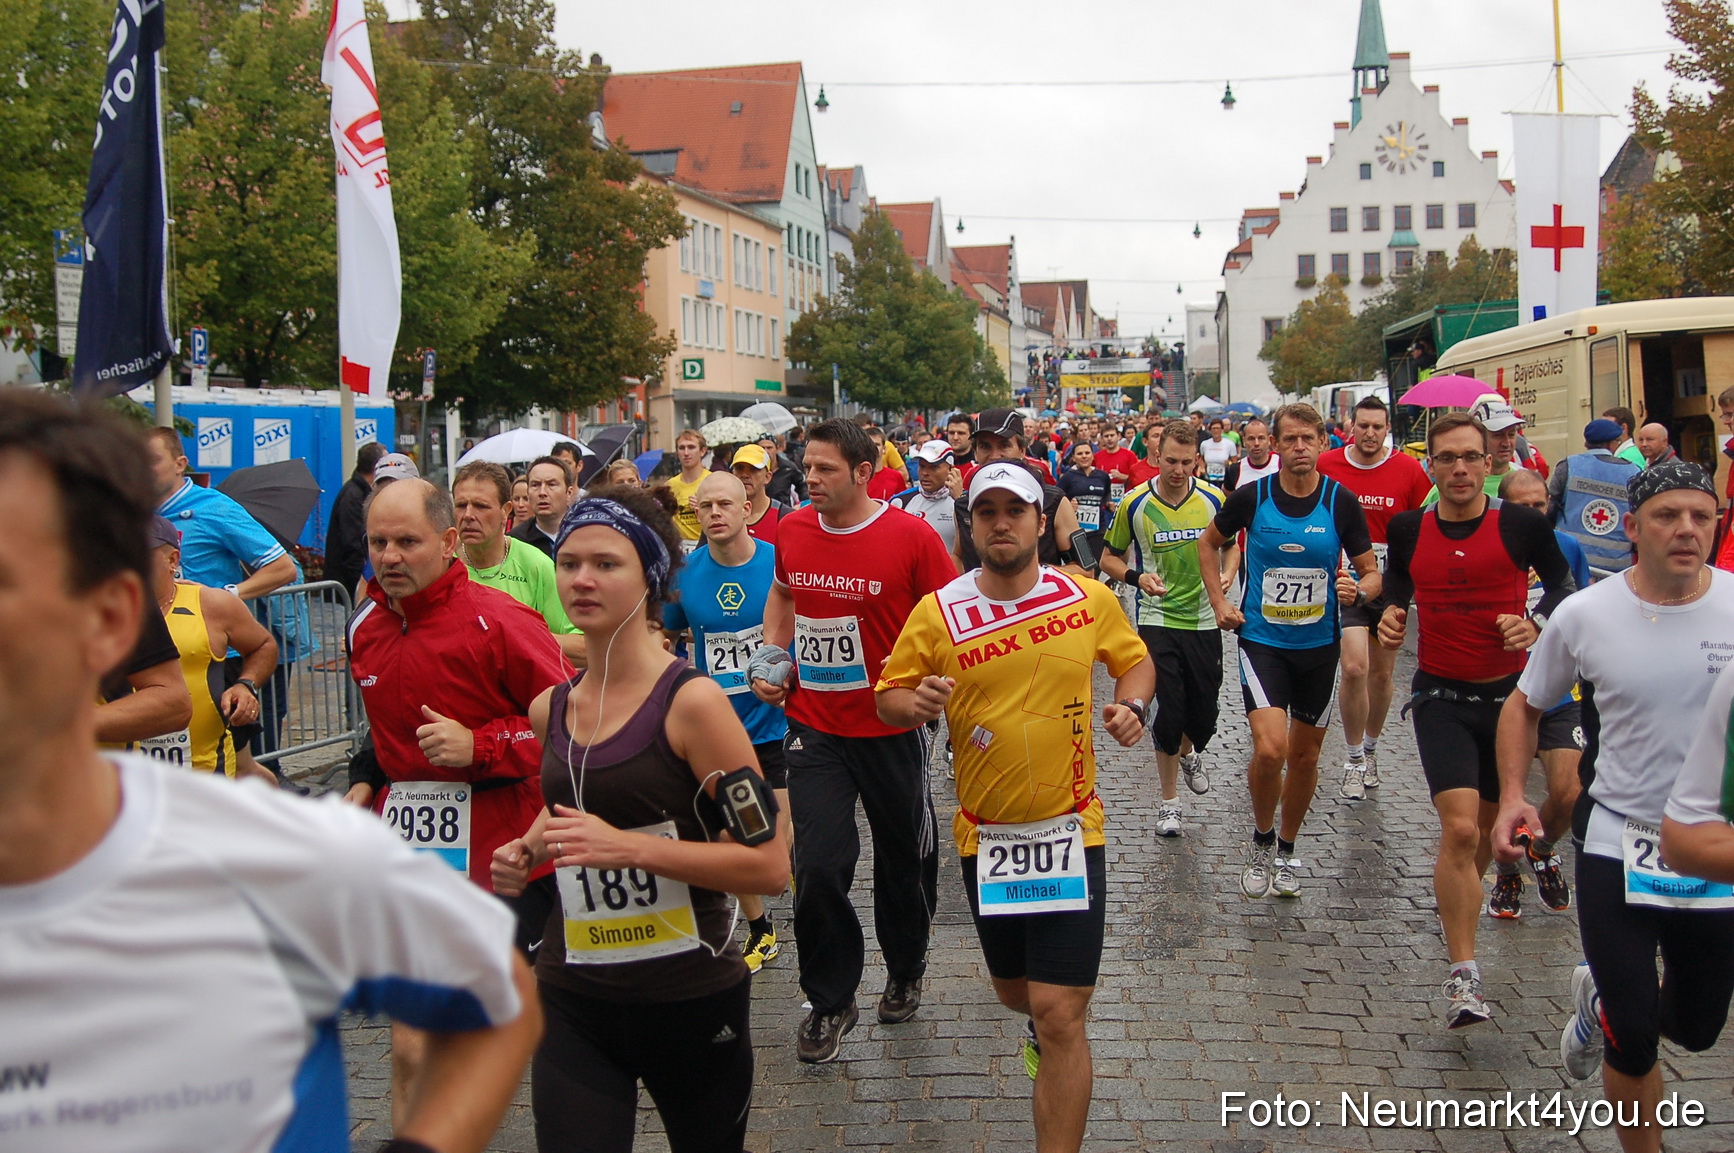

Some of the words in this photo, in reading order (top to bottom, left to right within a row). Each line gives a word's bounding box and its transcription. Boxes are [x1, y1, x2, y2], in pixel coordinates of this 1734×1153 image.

[195, 333, 204, 360] P
[685, 361, 701, 377] D
[1514, 357, 1564, 385] Bayerisches
[1090, 376, 1120, 384] START
[1514, 387, 1537, 406] Rotes
[355, 423, 375, 440] IXI
[508, 574, 528, 583] DEKRA
[788, 572, 865, 592] NEUMARKT
[829, 592, 848, 600] STARKE
[1275, 582, 1314, 604] 271
[1276, 608, 1312, 618] volkhard
[809, 625, 844, 634] Neumarkt
[957, 634, 1023, 671] MAX
[1028, 609, 1096, 645] BÖGL
[799, 635, 856, 664] 2379
[811, 669, 846, 682] Günther
[405, 791, 451, 801] Neumarkt
[387, 806, 459, 843] 2938
[981, 832, 1013, 841] PARTL
[1014, 826, 1062, 841] Neumarkt
[989, 837, 1072, 877] 2907
[575, 865, 659, 912] 189
[1006, 882, 1062, 900] Michael
[1651, 879, 1708, 894] Gerhard
[588, 924, 656, 945] Simone
